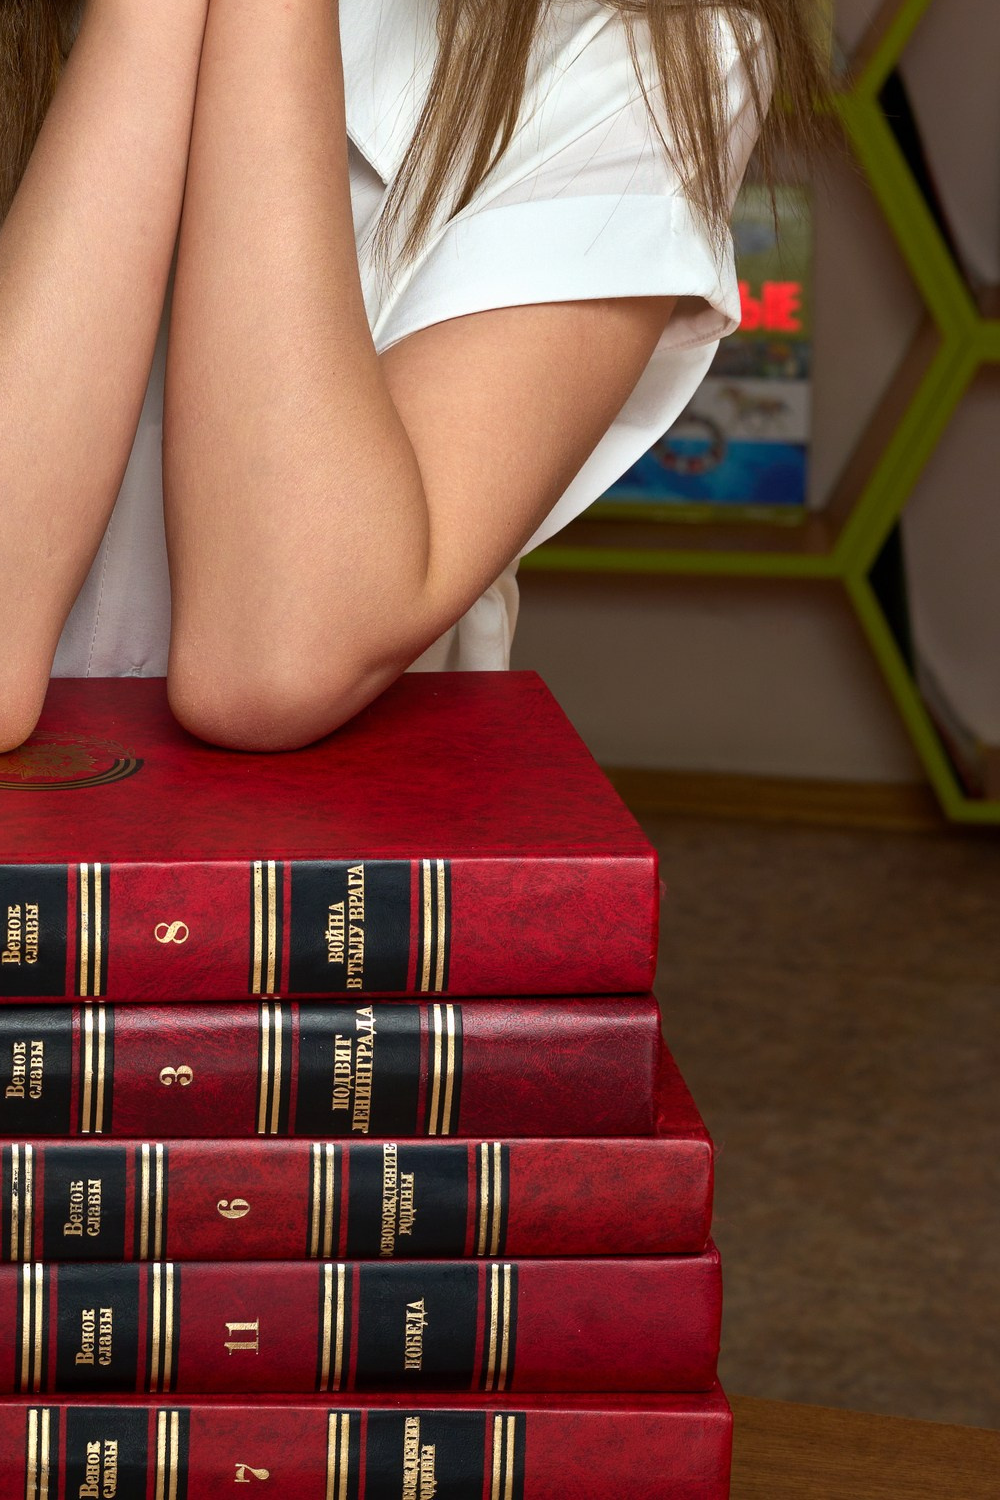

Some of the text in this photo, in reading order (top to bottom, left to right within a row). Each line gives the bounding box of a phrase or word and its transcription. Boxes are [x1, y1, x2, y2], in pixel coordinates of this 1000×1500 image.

[1, 903, 22, 966] Венок
[24, 902, 40, 965] славы
[154, 920, 190, 945] 8
[324, 900, 345, 965] ВОЙНА
[346, 862, 365, 990] В ТЫЛУ ВРАГА
[4, 1041, 27, 1099] Венок
[29, 1039, 44, 1100] славы
[159, 1064, 194, 1086] 3
[331, 1034, 353, 1111] ПОДВИГ
[352, 1003, 376, 1134] ЛЕНИНГРАДА
[63, 1179, 84, 1237] Венок
[86, 1178, 102, 1237] славы
[216, 1198, 251, 1219] 6
[398, 1171, 418, 1236] РОДИНЫ
[75, 1308, 96, 1365] Венок
[98, 1306, 113, 1366] славы
[223, 1318, 260, 1356] 11
[404, 1296, 429, 1371] ПОБЕДА
[79, 1440, 101, 1499] Венок
[102, 1438, 119, 1499] славы
[234, 1462, 270, 1483] 7
